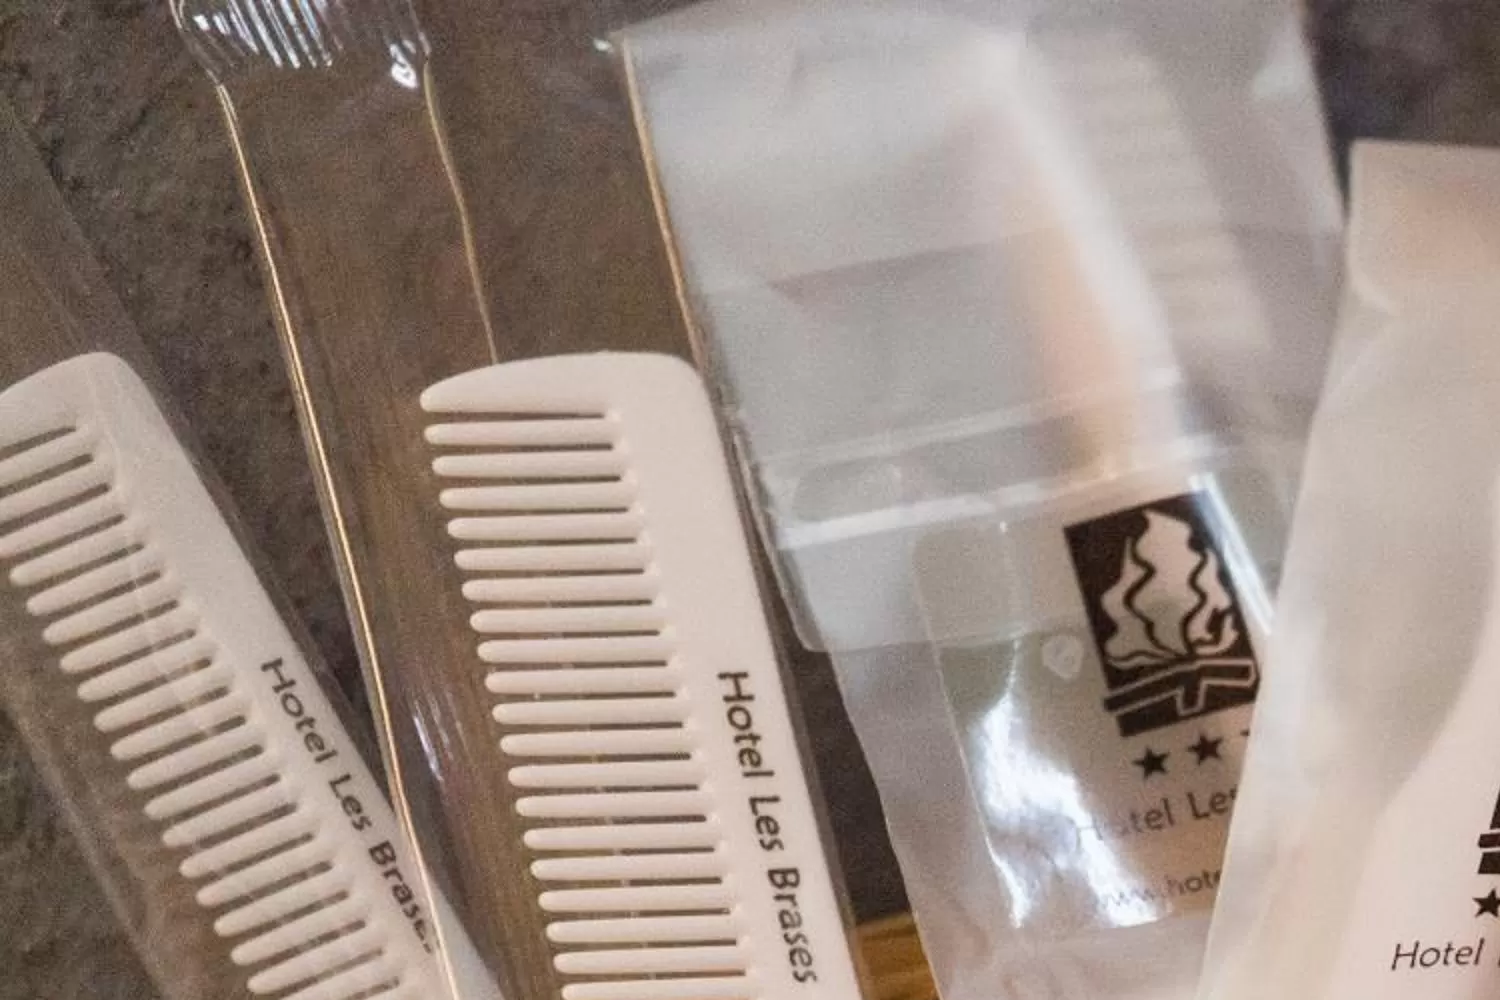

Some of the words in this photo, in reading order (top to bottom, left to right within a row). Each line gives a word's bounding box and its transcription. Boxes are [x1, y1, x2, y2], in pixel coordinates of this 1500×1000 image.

[260, 657, 338, 764] Hotel
[328, 774, 373, 833] Les
[717, 671, 775, 778] Hotel
[748, 796, 785, 852] Les
[767, 867, 818, 984] Brases
[1110, 797, 1176, 838] tel
[1391, 937, 1486, 972] Hotel
